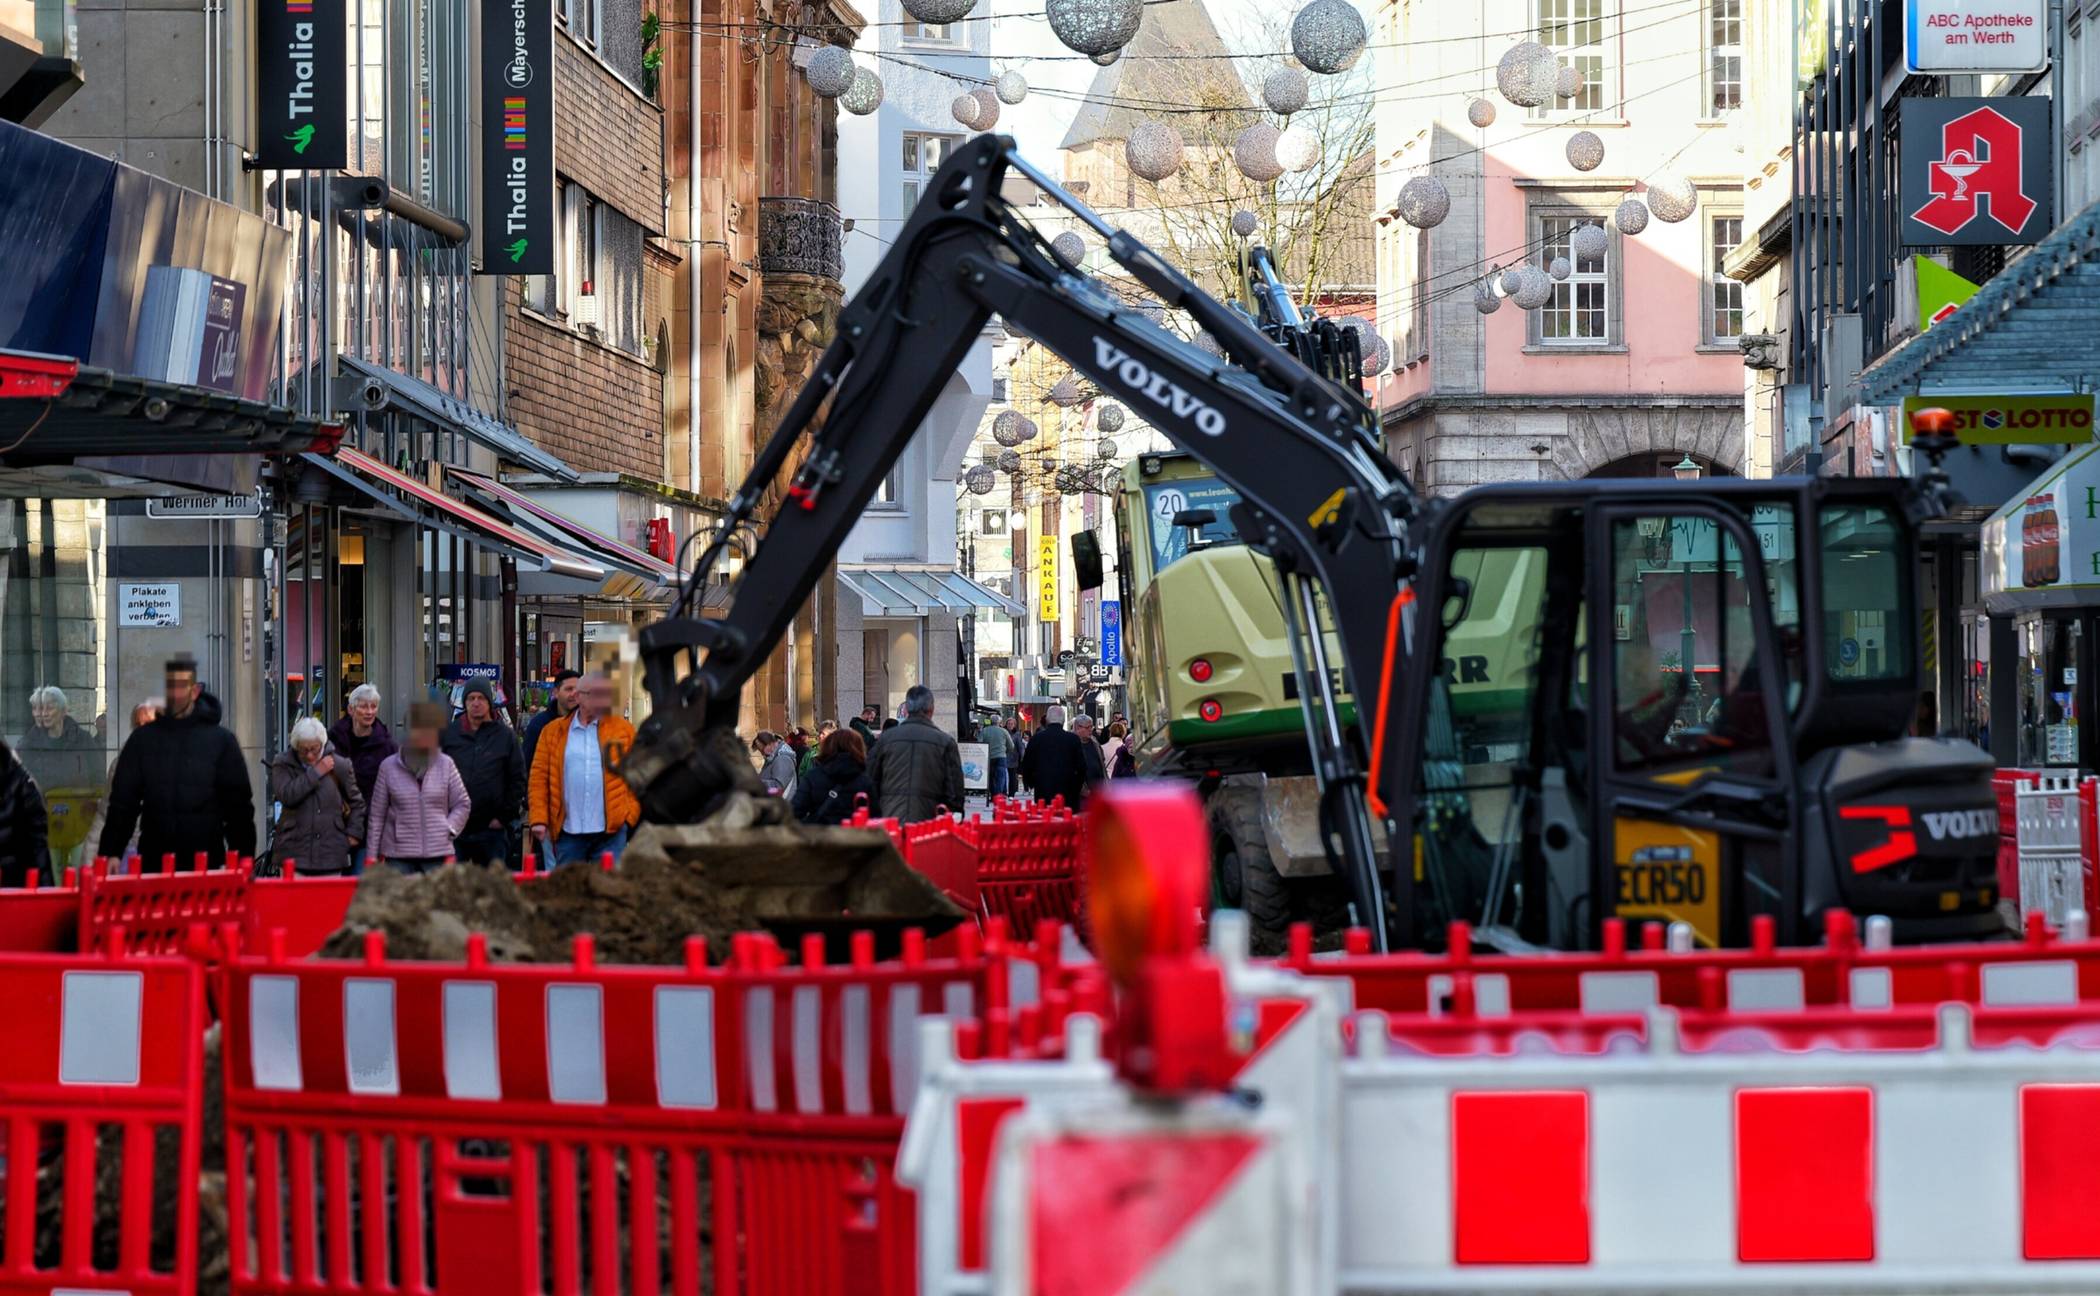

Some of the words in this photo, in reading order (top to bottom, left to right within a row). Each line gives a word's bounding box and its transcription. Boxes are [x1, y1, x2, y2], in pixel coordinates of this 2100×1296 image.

[1926, 14, 1960, 27] ABC
[1964, 14, 2033, 29] Apotheke
[1945, 34, 1968, 44] am
[1973, 32, 2015, 44] Werth
[289, 23, 313, 119] Thalia
[507, 157, 526, 235] Thalia
[1092, 335, 1227, 437] VOLVO
[2006, 408, 2092, 429] LOTTO
[1159, 494, 1182, 516] 20
[1043, 546, 1054, 614] ANKAUF
[132, 587, 167, 596] Plakate
[128, 600, 171, 608] ankleben
[1106, 631, 1117, 664] Apollo
[460, 667, 497, 677] KOSMOS
[1615, 863, 1706, 905] ECR50
